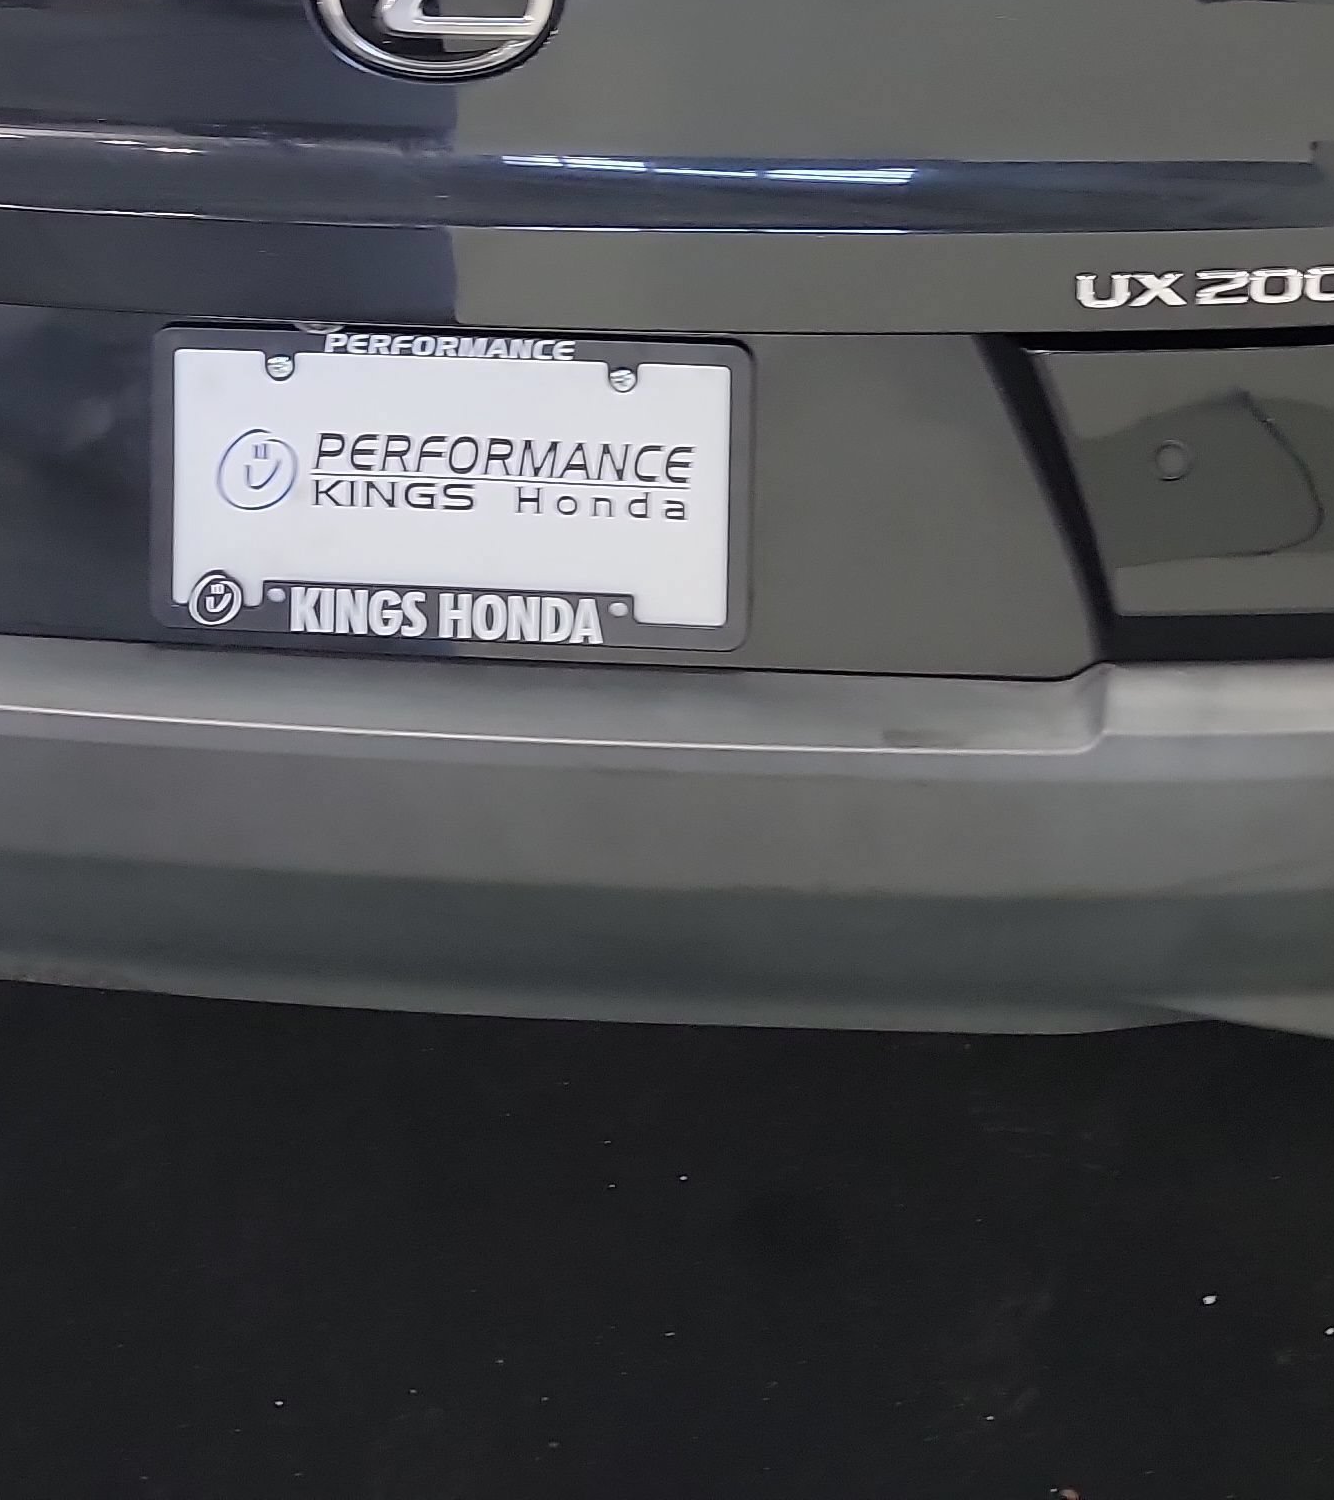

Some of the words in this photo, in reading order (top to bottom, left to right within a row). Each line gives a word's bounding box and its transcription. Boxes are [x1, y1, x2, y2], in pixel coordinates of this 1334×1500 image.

[1075, 272, 1188, 309] UX
[324, 333, 575, 361] PERFORMANCE
[314, 432, 696, 483] PERFORMANCE
[312, 481, 475, 511] KINGS
[514, 485, 688, 521] Honda
[290, 586, 427, 638] KINGS
[438, 593, 604, 645] HONDA
